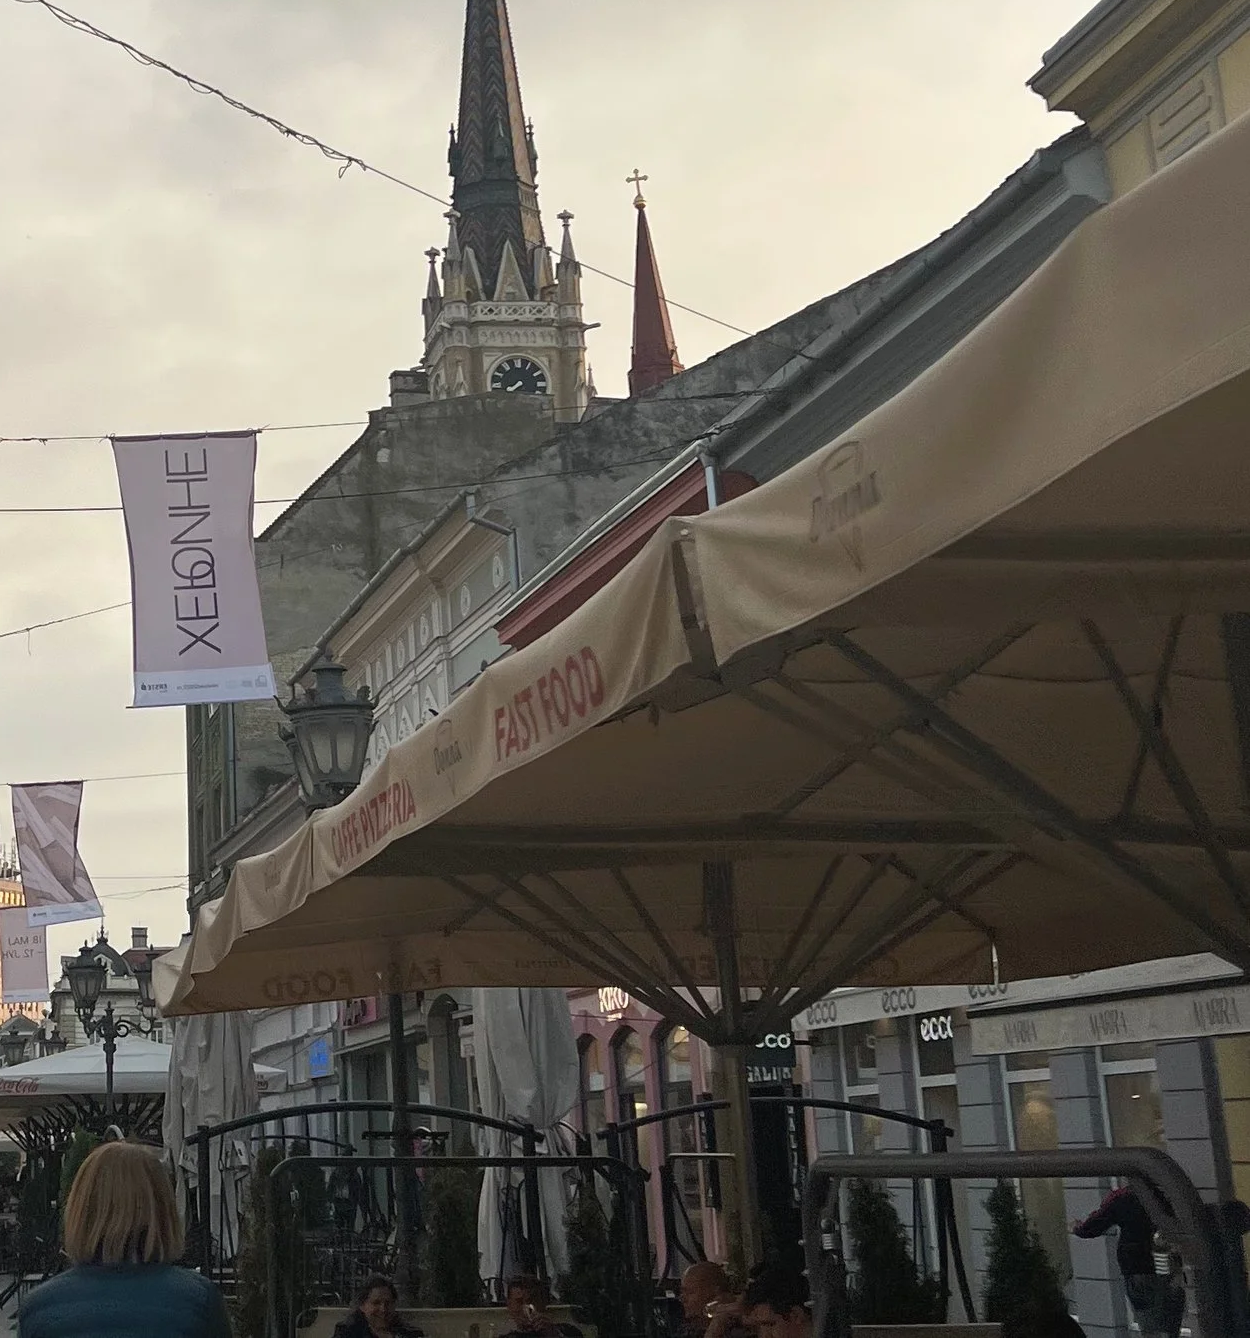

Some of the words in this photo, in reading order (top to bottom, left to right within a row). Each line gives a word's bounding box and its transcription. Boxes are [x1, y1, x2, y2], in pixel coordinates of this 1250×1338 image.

[494, 687, 540, 762] FAST
[537, 646, 605, 736] FOOD
[331, 812, 362, 868] CAFFE
[598, 987, 629, 1013] KIKO
[881, 987, 917, 1013] ecco
[806, 1002, 837, 1026] ecco
